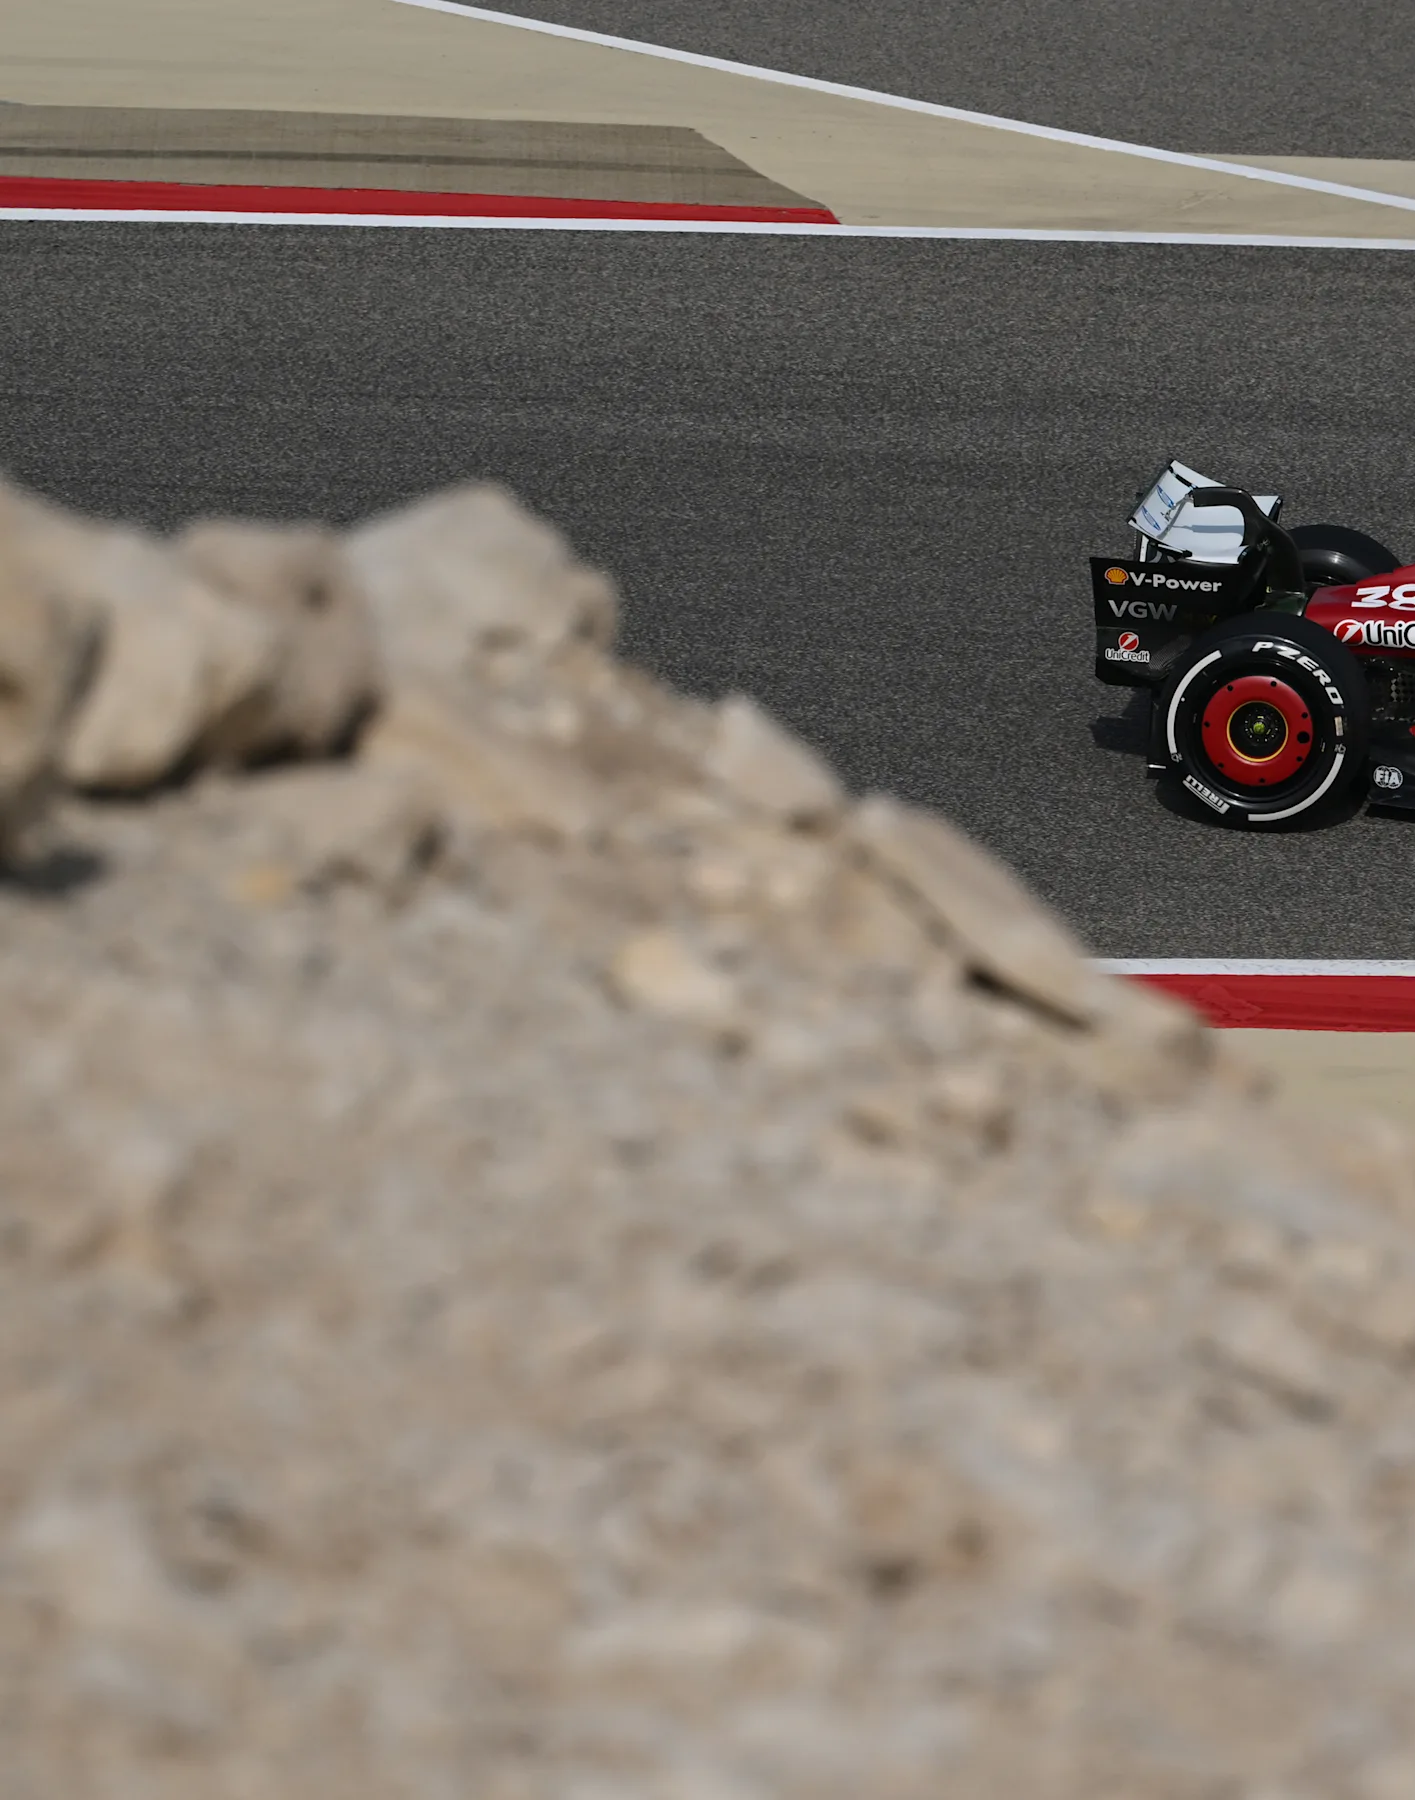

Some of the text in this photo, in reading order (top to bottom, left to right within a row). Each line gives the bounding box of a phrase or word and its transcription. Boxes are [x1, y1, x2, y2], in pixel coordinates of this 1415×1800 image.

[1129, 571, 1222, 592] V-Power
[1108, 600, 1178, 622] VGW
[1105, 647, 1150, 663] UniCredit
[1252, 641, 1344, 705] P ZERO
[1182, 774, 1231, 815] PIRELLI
